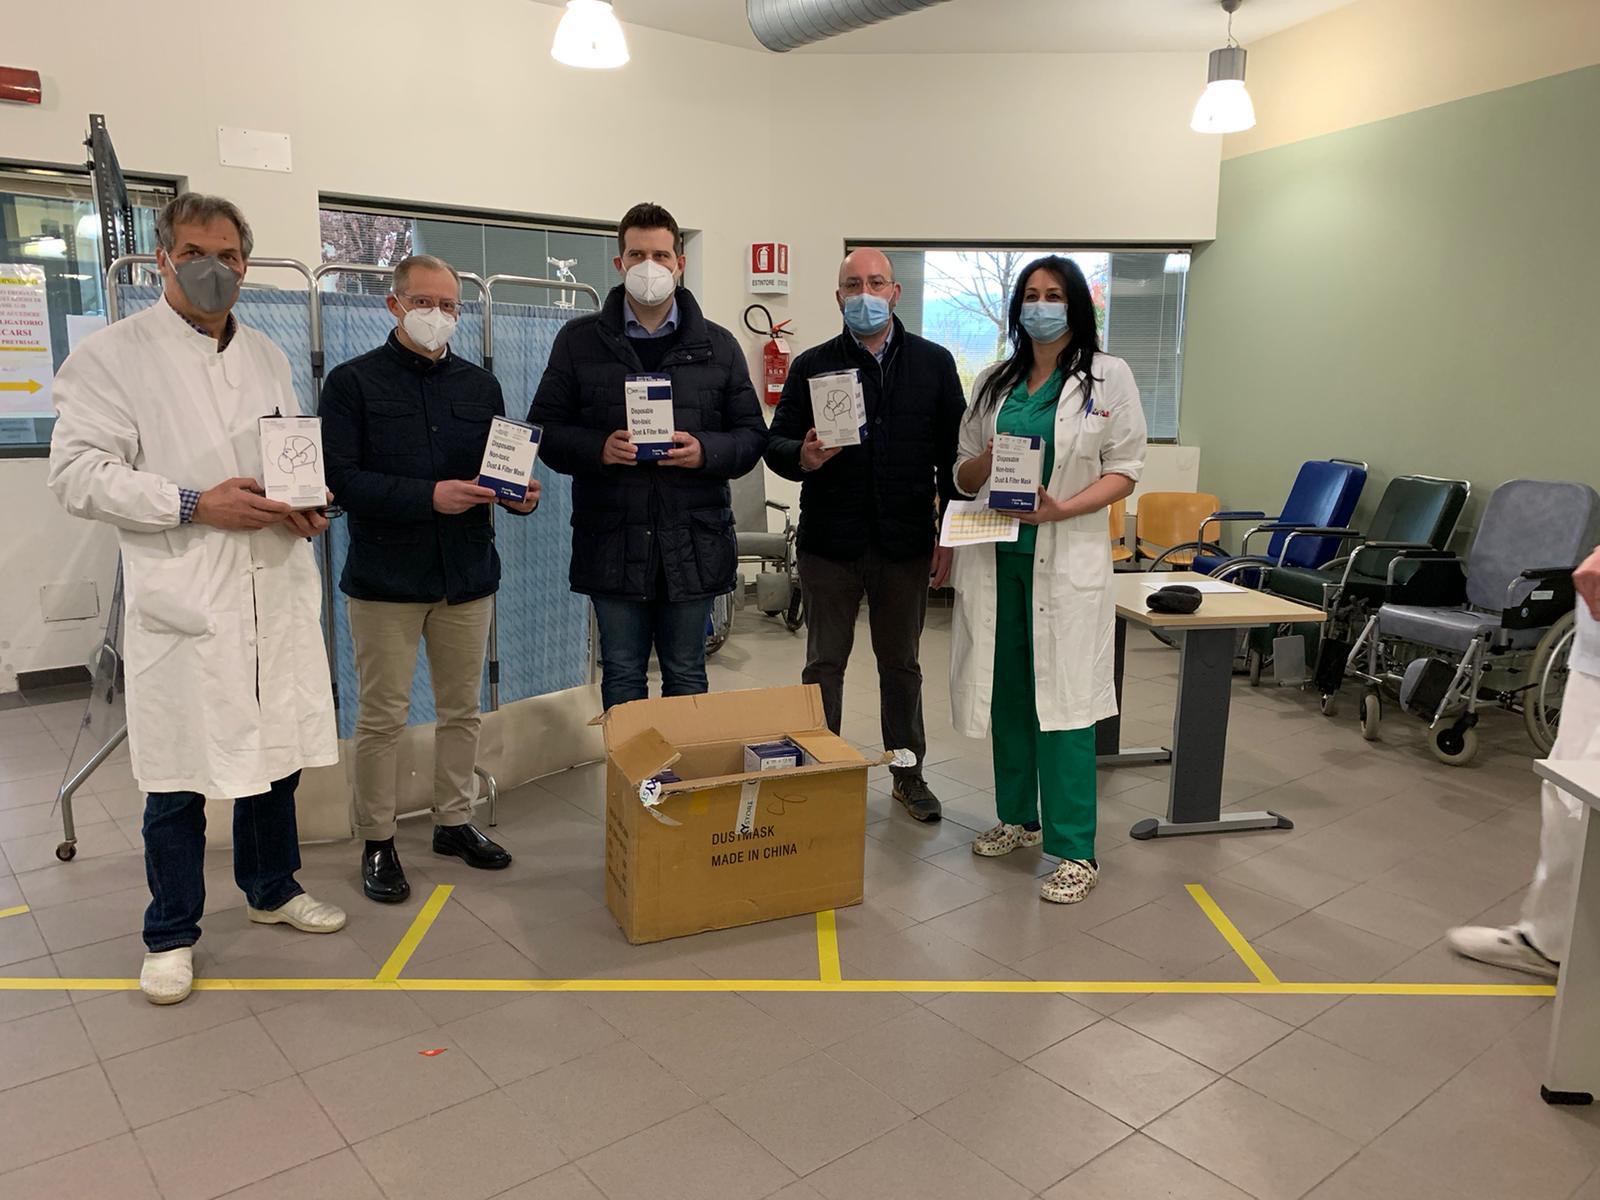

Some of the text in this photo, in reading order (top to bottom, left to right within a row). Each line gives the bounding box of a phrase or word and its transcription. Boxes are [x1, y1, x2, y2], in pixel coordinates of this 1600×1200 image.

[0, 319, 44, 327] LIGATORIO
[0, 328, 32, 337] CARSI
[491, 440, 516, 452] Disposable
[486, 460, 497, 470] Dust
[501, 464, 514, 474] Filter
[712, 843, 798, 867] MADE IN CHINA
